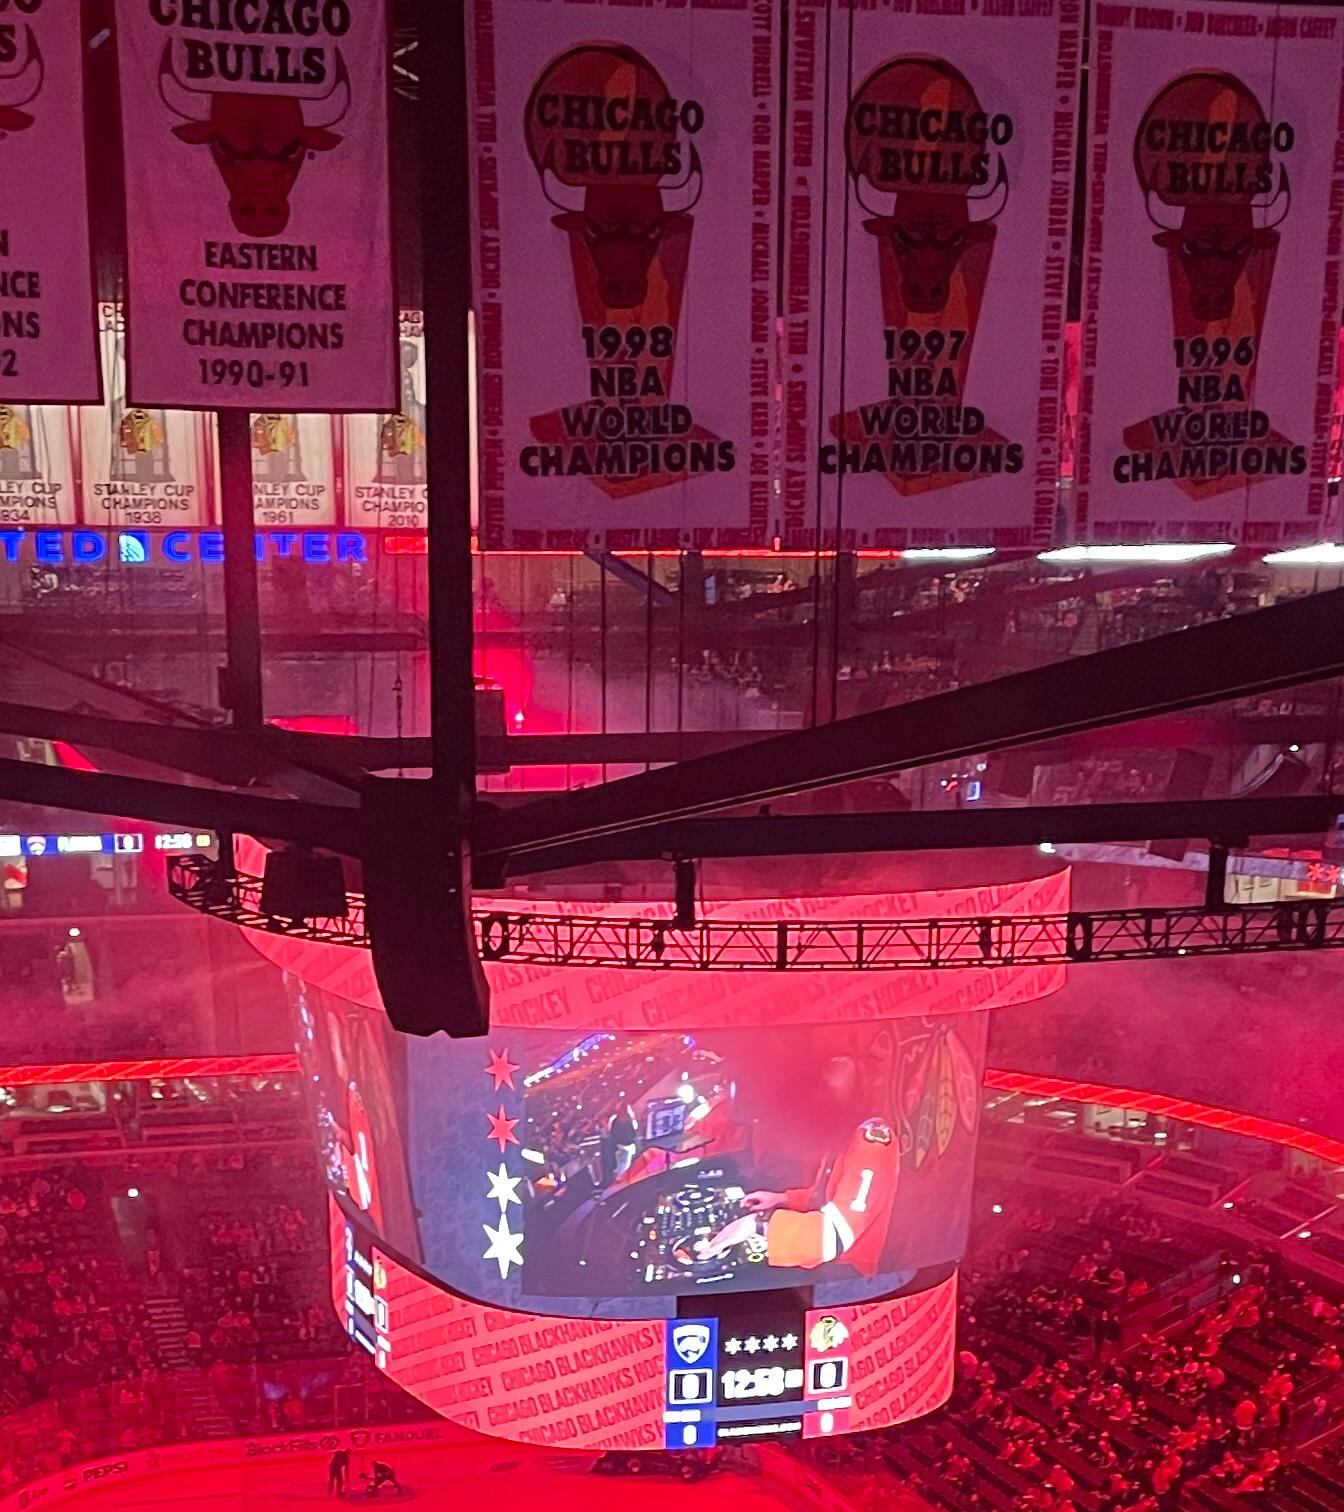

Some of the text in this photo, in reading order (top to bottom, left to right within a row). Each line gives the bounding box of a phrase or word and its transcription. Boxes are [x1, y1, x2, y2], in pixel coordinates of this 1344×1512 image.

[150, 0, 352, 36] CHICAGO
[186, 39, 327, 84] BULLS
[537, 94, 704, 134] CHICAGO
[856, 104, 1014, 146] CHICAGO
[1145, 120, 1295, 153] CHICAGO
[564, 139, 684, 176] BULLS
[878, 147, 992, 186] BULLS
[1167, 160, 1274, 195] BULLS
[205, 242, 318, 271] EASTERN
[180, 279, 347, 310] CONFERENCE
[183, 319, 344, 349] CHAMPIONS
[582, 325, 674, 359] 1998
[883, 329, 968, 361] 1997
[1174, 337, 1254, 368] 1996
[199, 358, 310, 387] 1990-91
[590, 366, 663, 398] NBA
[888, 366, 957, 398] NBA
[1178, 374, 1244, 404] NBA
[562, 404, 693, 438] WORLD
[860, 406, 985, 437] WORLD
[1151, 410, 1270, 443] WORLD
[519, 441, 736, 477] CHAMPIONS
[819, 443, 1024, 474] CHAMPIONS
[1113, 446, 1307, 484] CHAMPIONS
[94, 484, 195, 498] STANLEY CUP
[102, 496, 190, 511] CHAMPIONS
[294, 484, 326, 498] CUP
[356, 485, 416, 499] STANLEY
[263, 511, 295, 525] 1961
[557, 1326, 655, 1377] BLACKHAWKS
[541, 1365, 634, 1414] BLACKHAWKS
[82, 1461, 129, 1483] PEPSI
